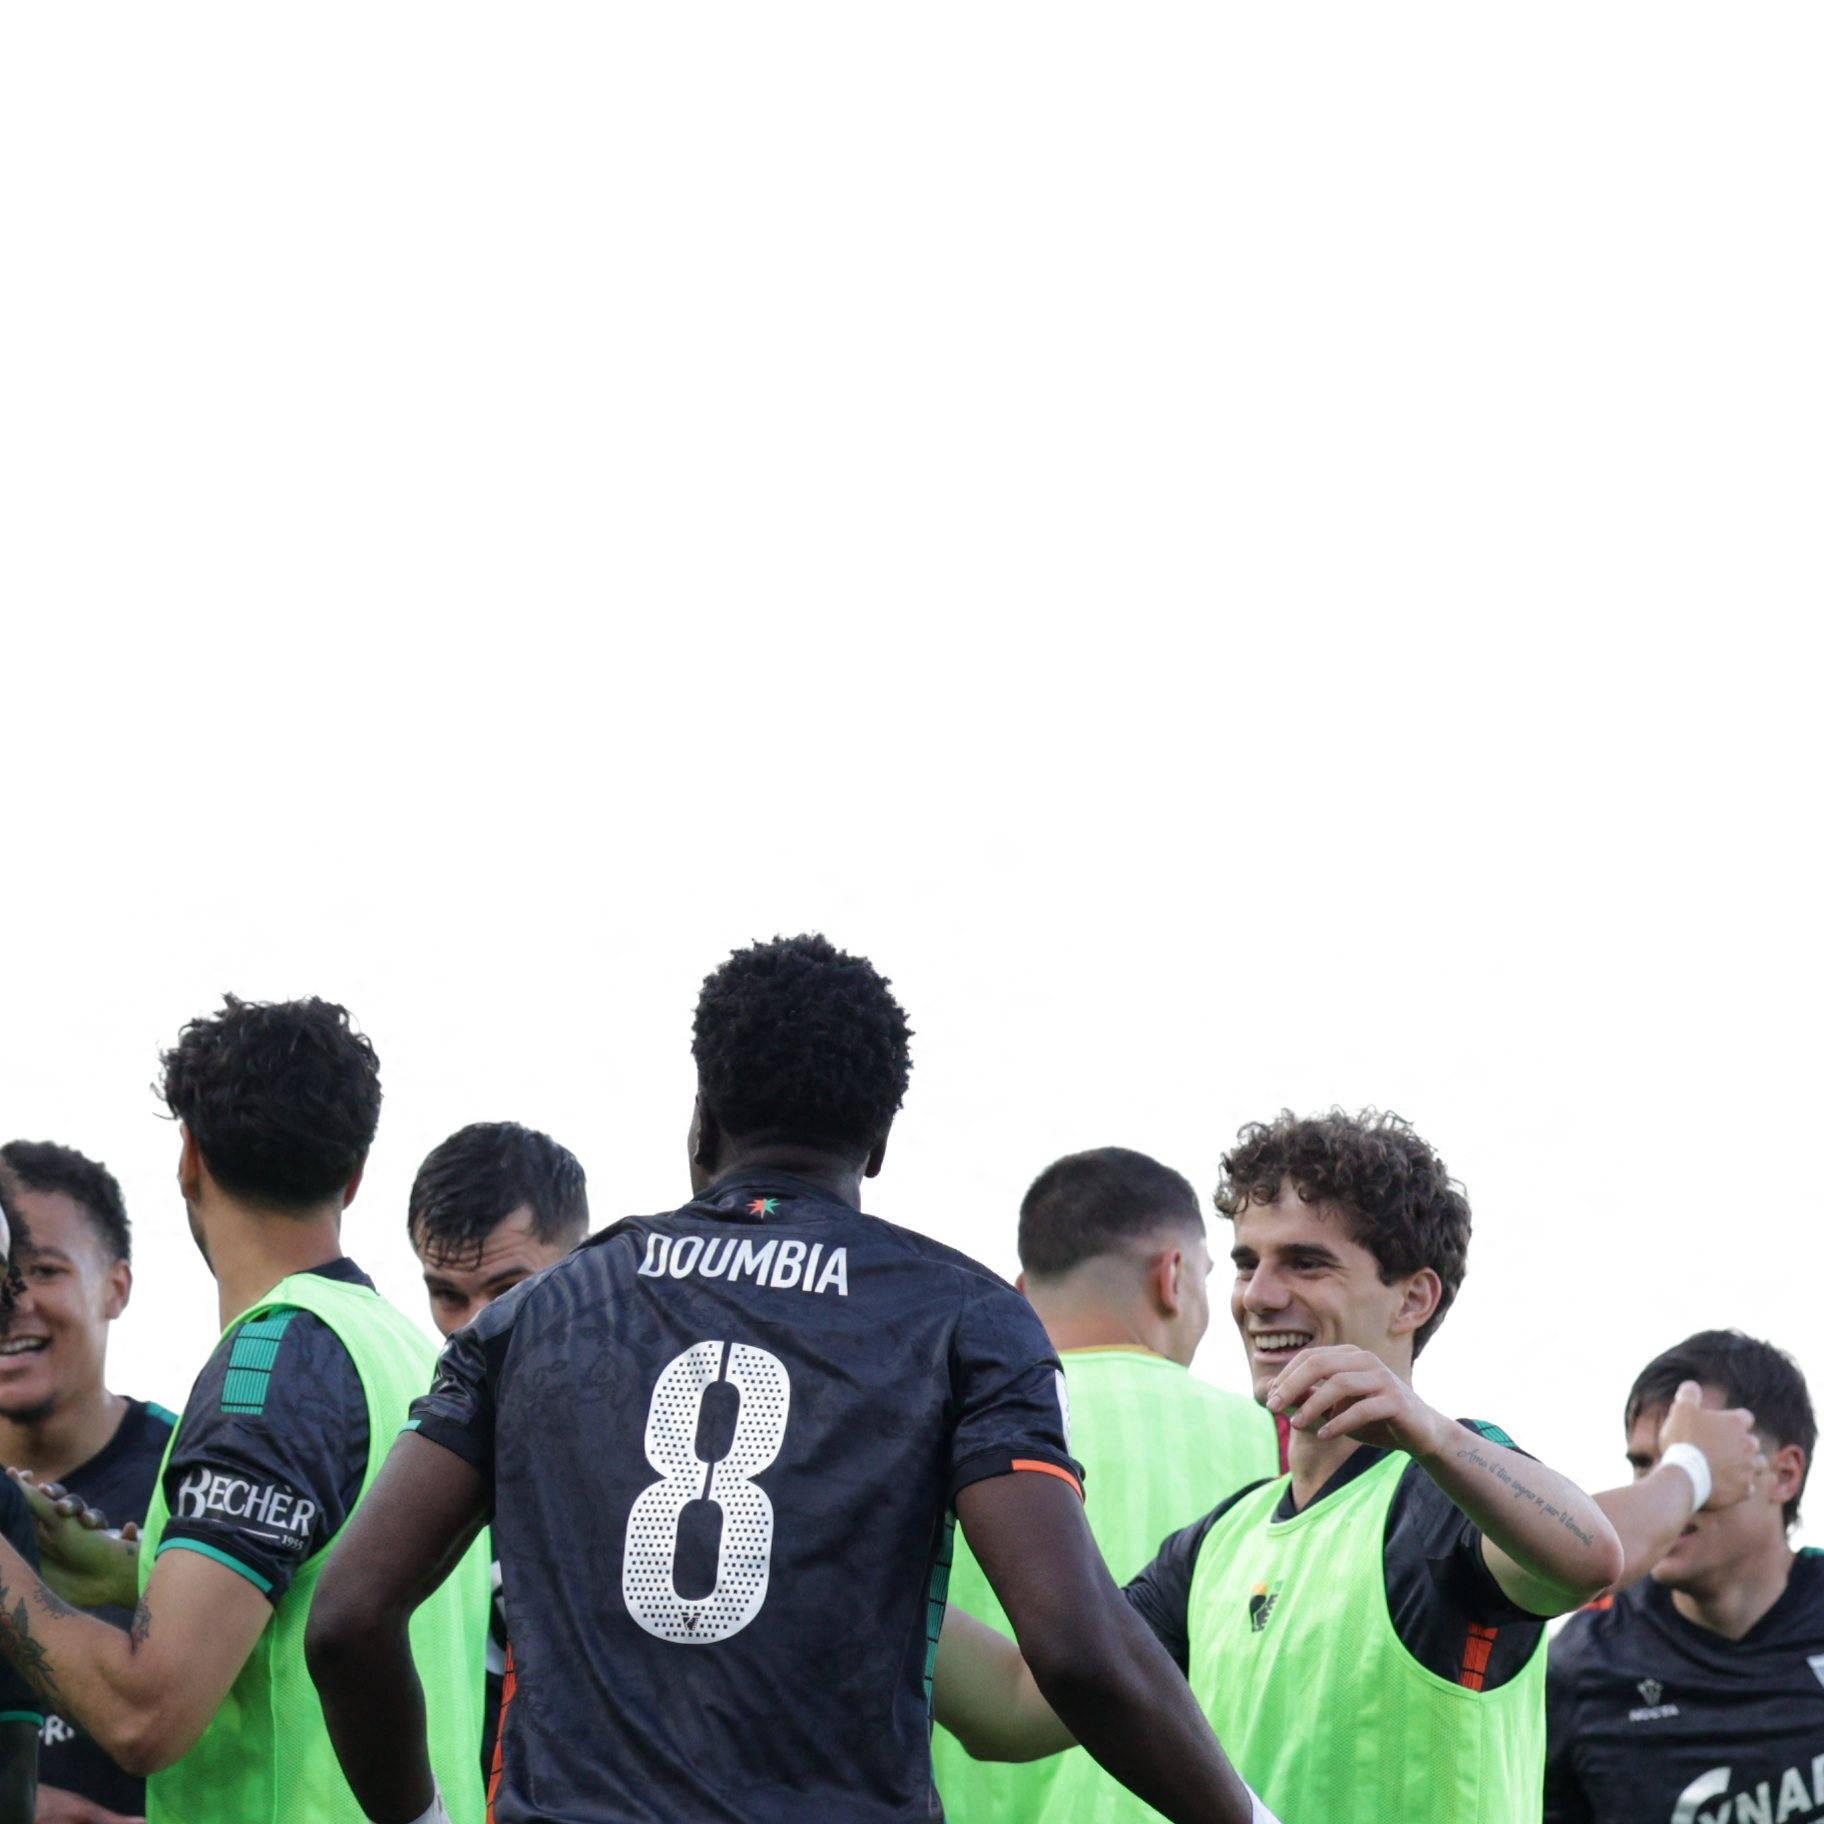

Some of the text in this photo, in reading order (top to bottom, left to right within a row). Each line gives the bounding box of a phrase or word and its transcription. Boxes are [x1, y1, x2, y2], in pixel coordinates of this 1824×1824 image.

[637, 1232, 849, 1297] DOUMBIA
[178, 1466, 316, 1537] BECHÈR
[622, 1340, 790, 1644] 8
[281, 1534, 305, 1551] 1955
